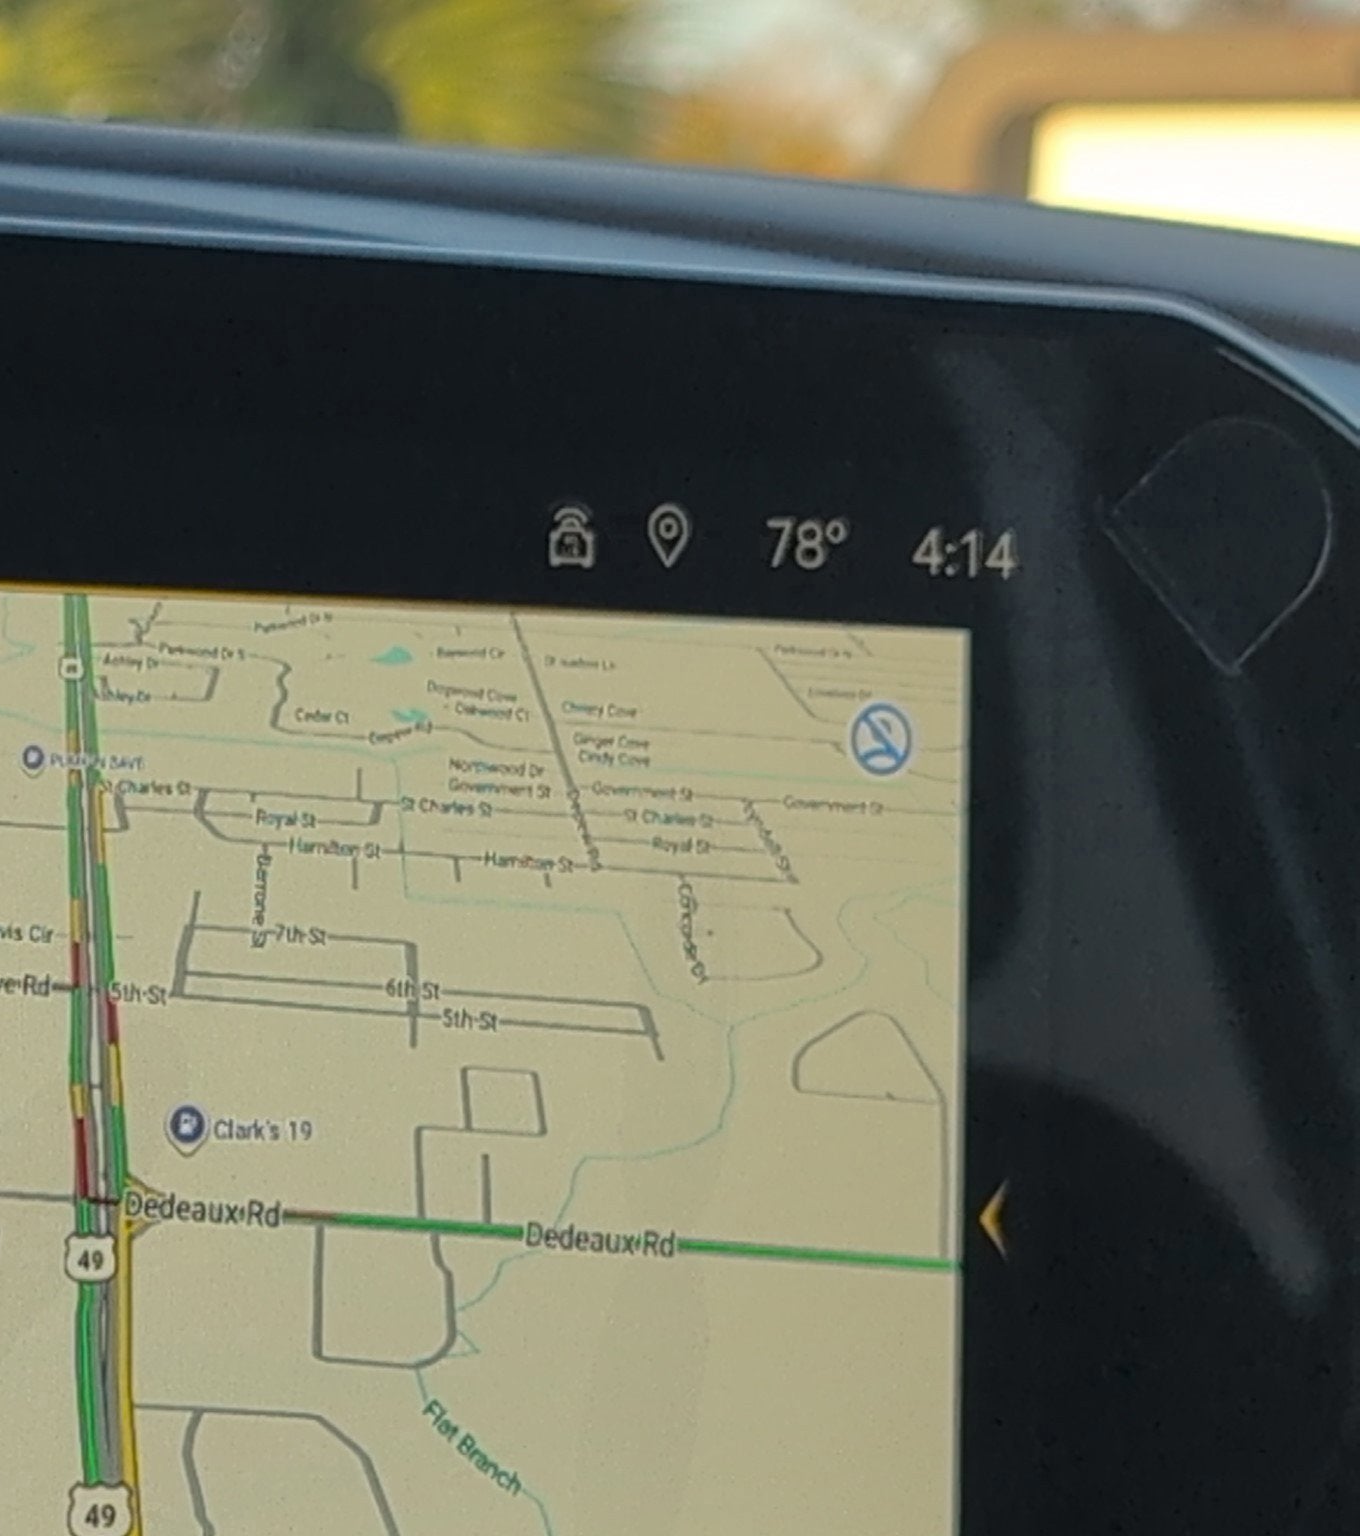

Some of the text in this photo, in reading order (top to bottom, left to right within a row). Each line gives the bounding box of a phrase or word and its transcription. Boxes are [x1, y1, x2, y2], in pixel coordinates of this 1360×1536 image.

[912, 527, 1017, 580] 4:14
[29, 925, 53, 943] Cir
[275, 925, 327, 945] 7th St
[23, 975, 50, 997] Rd
[110, 982, 167, 1005] 5th St
[385, 978, 440, 1000] 6th St
[442, 1008, 498, 1032] 5th St
[214, 1120, 313, 1141] Clark's 19
[124, 1193, 280, 1229] Dedeaux Rd
[525, 1220, 675, 1258] Dedeaux Rd
[77, 1250, 105, 1272] 49
[422, 1398, 522, 1497] Flat Branch
[84, 1504, 117, 1528] 49
